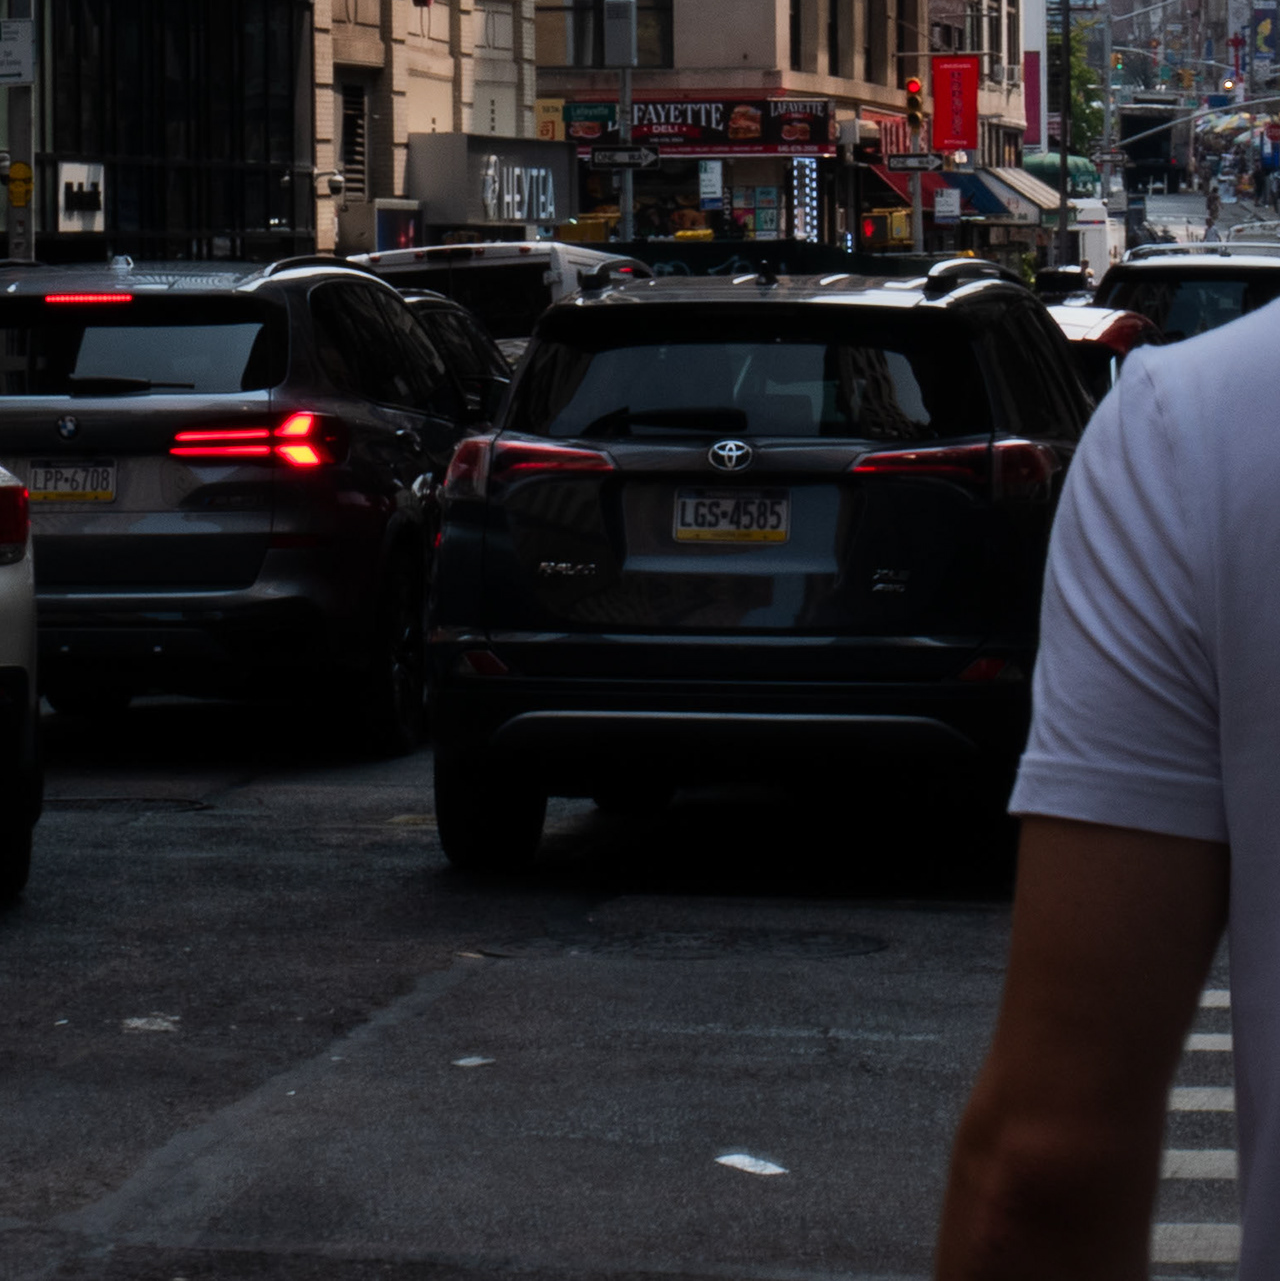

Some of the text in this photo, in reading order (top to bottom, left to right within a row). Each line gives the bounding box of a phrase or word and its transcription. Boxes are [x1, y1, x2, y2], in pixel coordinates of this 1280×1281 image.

[607, 103, 724, 132] LFAYETTE
[770, 101, 825, 118] LAFAYETTE
[652, 124, 679, 134] DELI
[503, 167, 556, 219] HEYTEA
